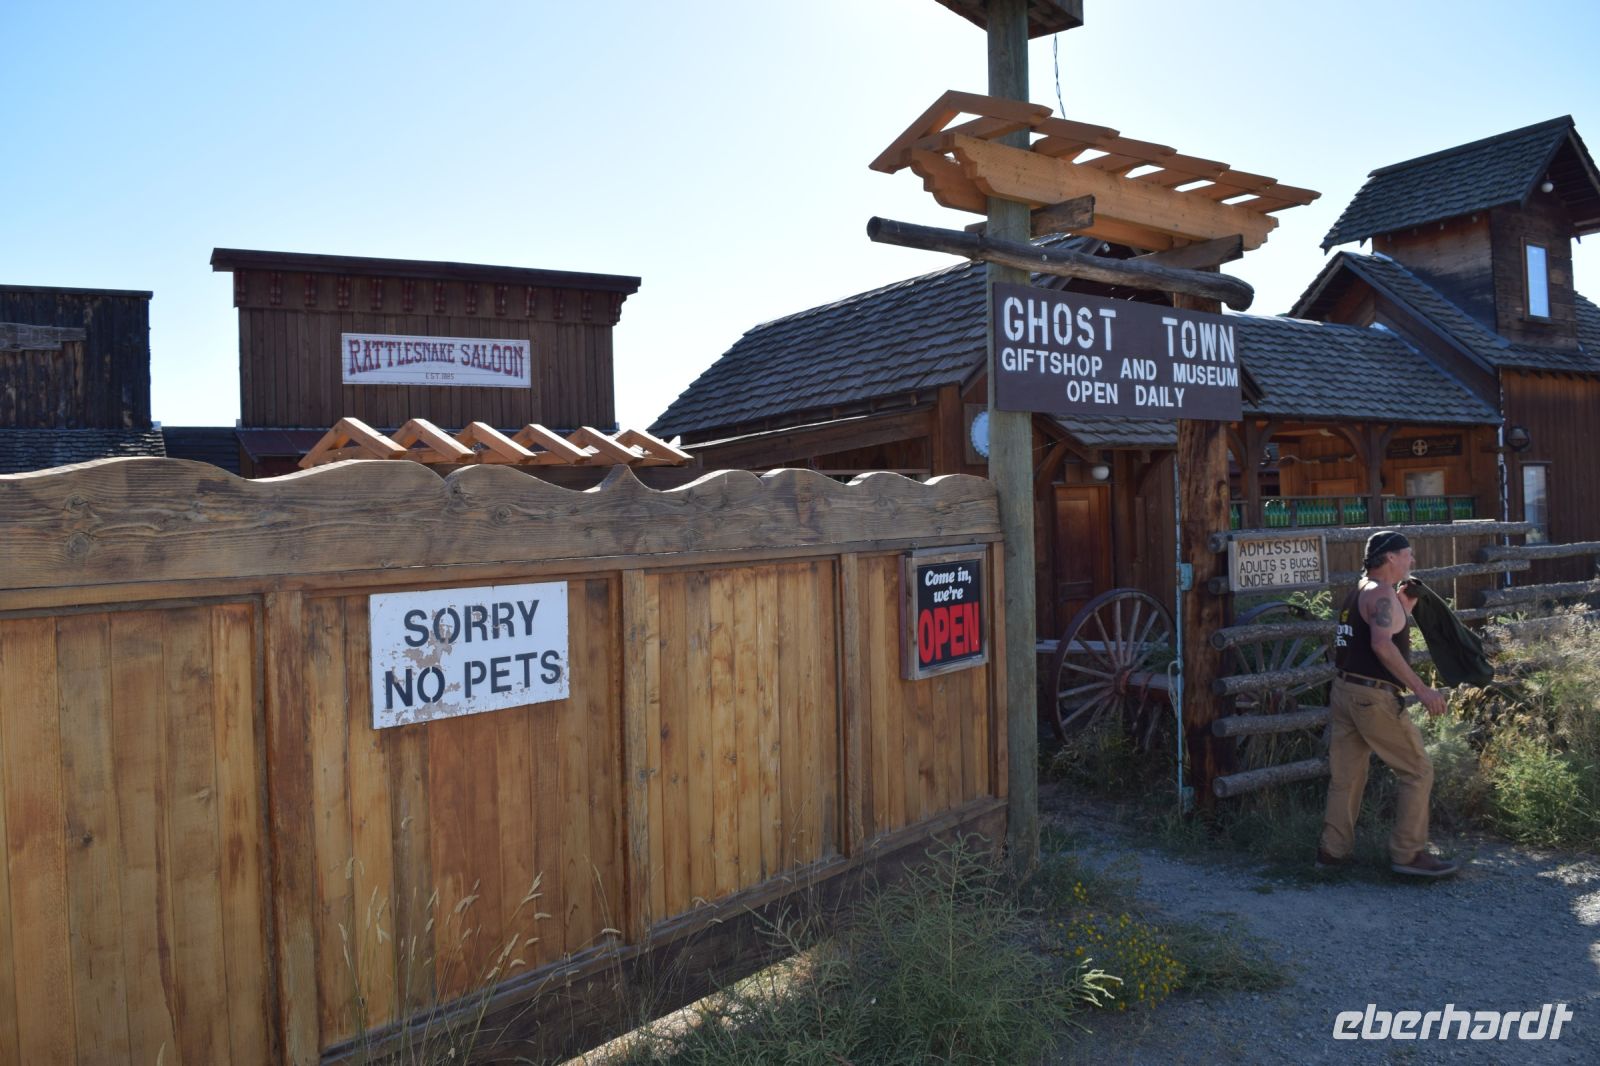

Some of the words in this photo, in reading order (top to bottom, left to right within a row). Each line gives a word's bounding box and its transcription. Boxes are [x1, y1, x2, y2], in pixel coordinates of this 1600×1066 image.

[1003, 296, 1117, 351] GHOST
[1162, 317, 1235, 363] TOWN
[348, 339, 455, 375] RATTLESNAKE
[461, 343, 524, 379] SALOON
[1001, 347, 1103, 378] GIFTSHOP
[1120, 358, 1157, 381] AND
[1172, 362, 1239, 387] MUSEUM
[1066, 380, 1118, 405] OPEN
[1135, 385, 1185, 408] DAILY
[1239, 539, 1318, 557] ADMISSION
[925, 570, 956, 586] Come
[957, 566, 972, 584] in,
[1239, 573, 1275, 588] UNDER
[1280, 573, 1290, 583] 12
[1293, 569, 1320, 584] FREE
[1240, 559, 1277, 574] ADULTS
[1280, 559, 1287, 570] 5
[1290, 557, 1318, 570] BUCKS
[933, 585, 964, 603] we're
[404, 599, 540, 648] SORRY
[917, 601, 980, 664] OPEN
[385, 666, 446, 709] NO
[464, 650, 561, 699] PETS
